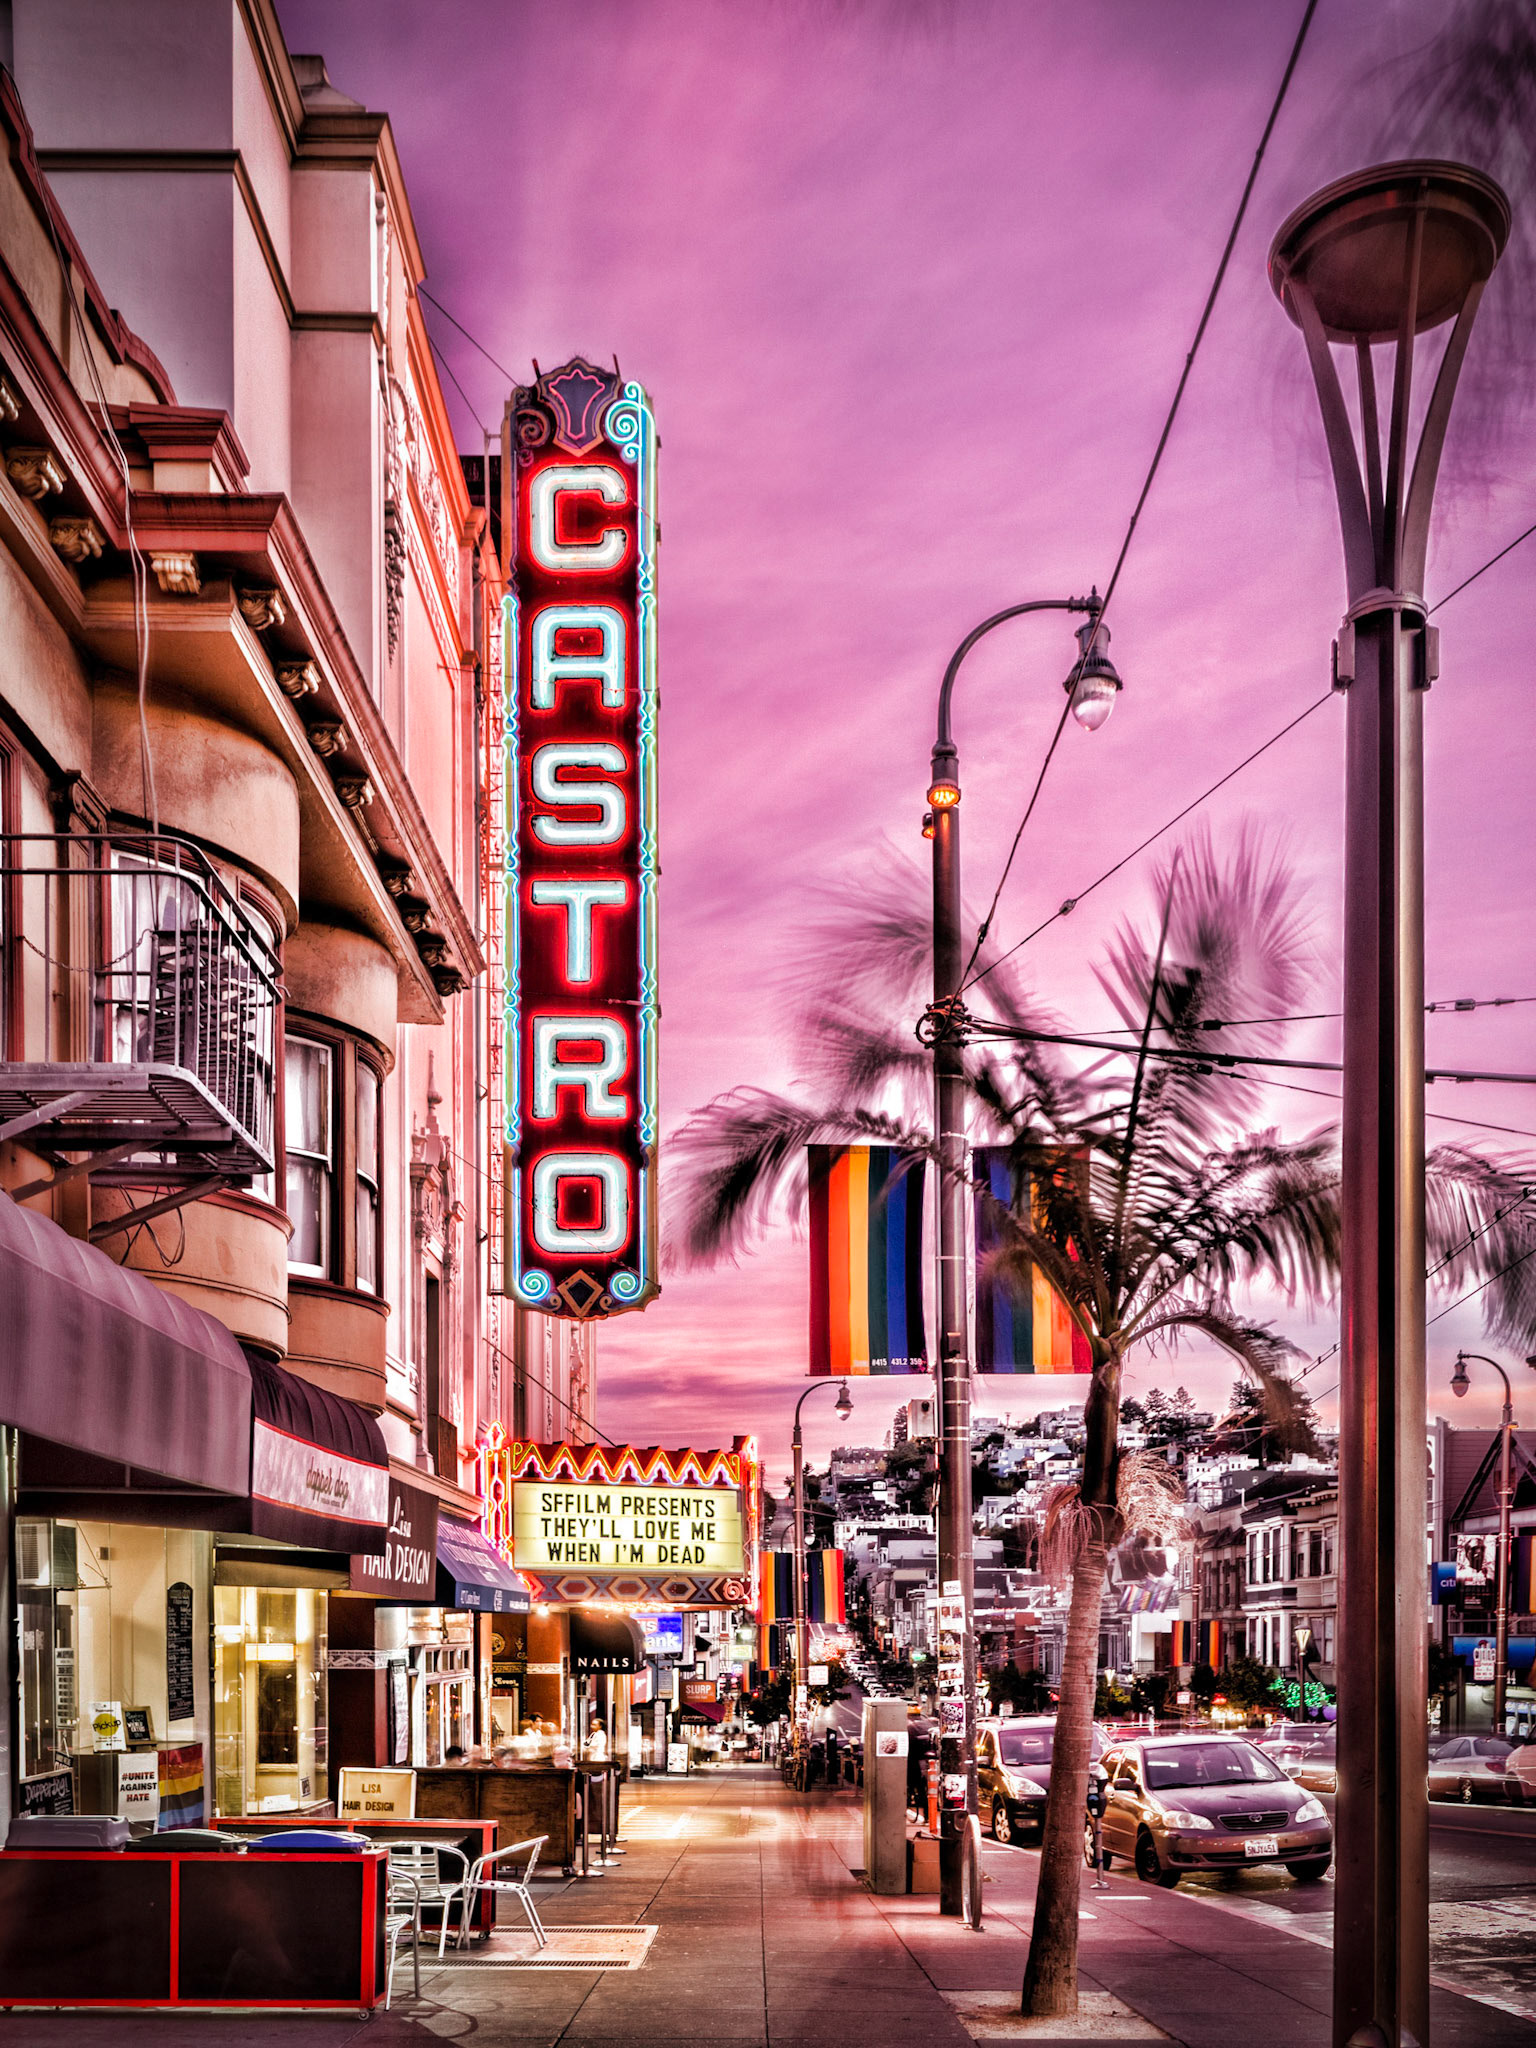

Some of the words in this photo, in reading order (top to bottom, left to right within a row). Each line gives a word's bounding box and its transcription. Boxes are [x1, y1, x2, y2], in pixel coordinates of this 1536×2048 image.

[531, 464, 628, 1253] CASTRO
[306, 1456, 333, 1502] dapper
[334, 1467, 350, 1510] dog
[542, 1493, 611, 1514] SFFILM
[621, 1496, 715, 1518] PRESENTS
[389, 1495, 412, 1538] Lisa
[541, 1517, 621, 1538] THEY'LL
[634, 1520, 680, 1540] LOVE
[691, 1522, 716, 1541] ME
[547, 1542, 601, 1563] WHEN
[615, 1544, 644, 1563] I'M
[658, 1545, 705, 1564] DEAD
[395, 1544, 431, 1585] DESIGN
[646, 1632, 679, 1648] ank
[577, 1657, 630, 1668] NAILS
[684, 1684, 712, 1695] SLURP
[121, 1771, 155, 1781] #UNITE
[120, 1782, 158, 1792] AGAINST
[361, 1783, 382, 1794] LISA
[126, 1793, 150, 1803] HATE
[342, 1800, 361, 1811] HAIR
[365, 1801, 395, 1812] DESIGN
